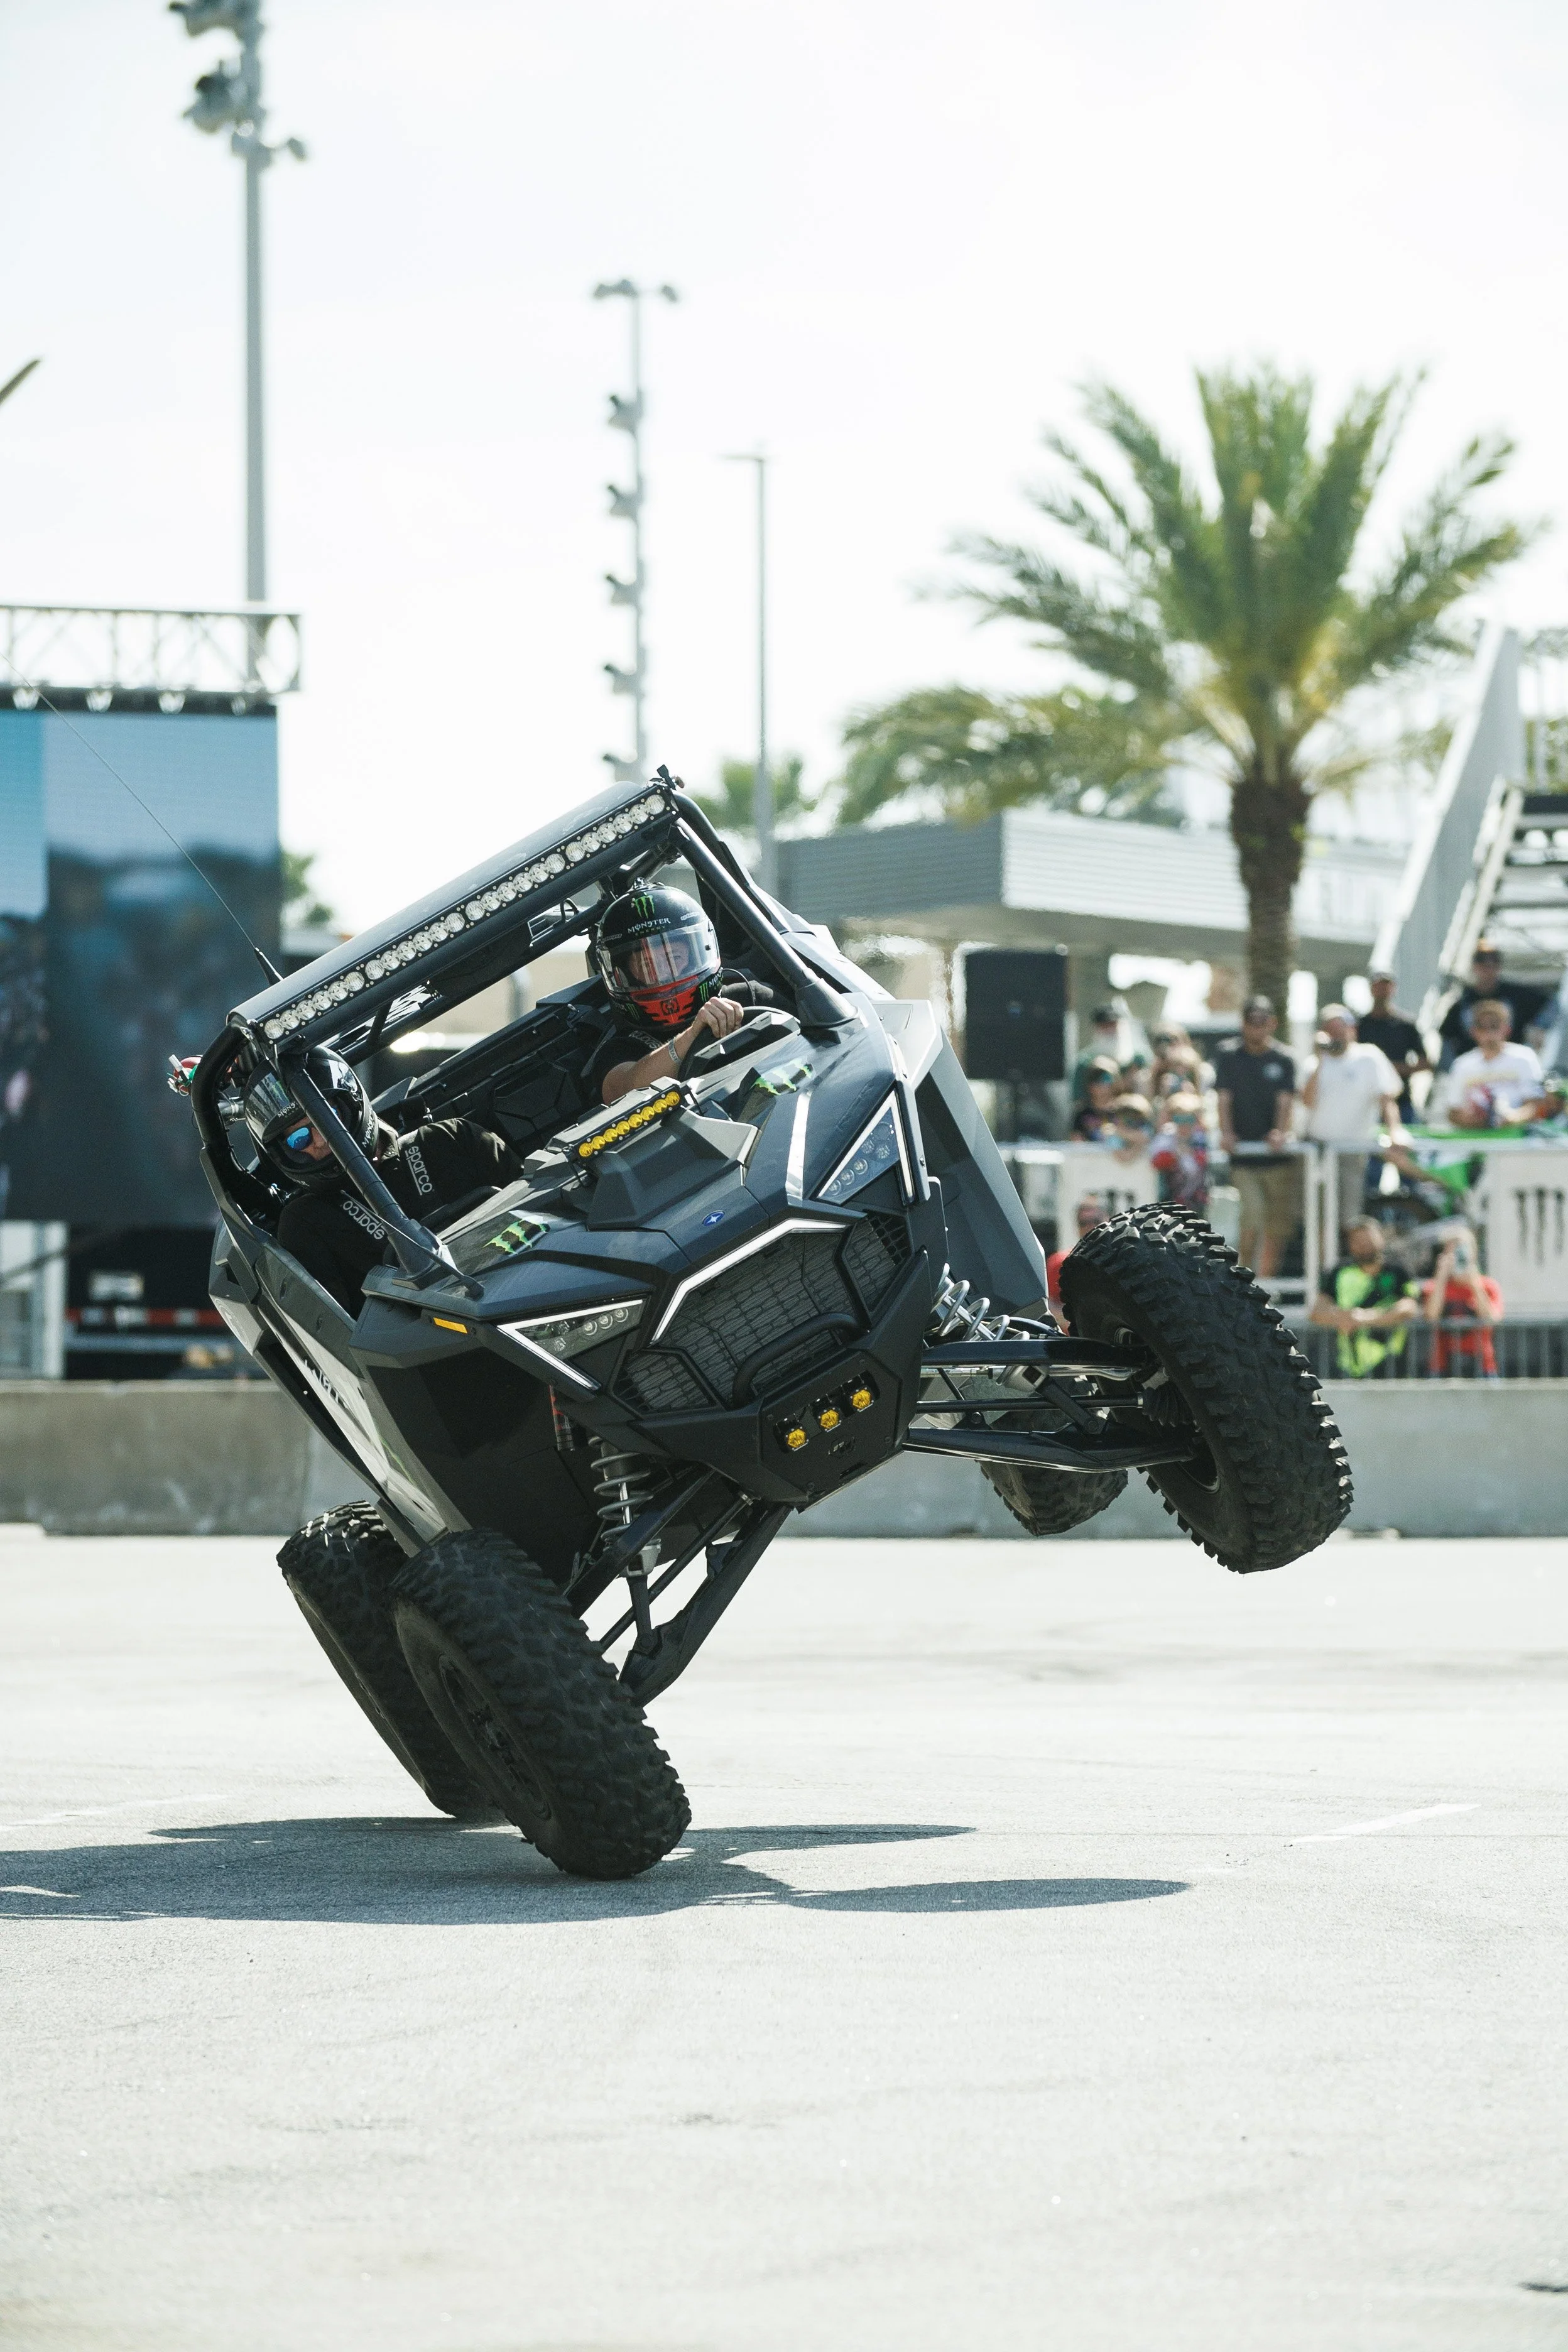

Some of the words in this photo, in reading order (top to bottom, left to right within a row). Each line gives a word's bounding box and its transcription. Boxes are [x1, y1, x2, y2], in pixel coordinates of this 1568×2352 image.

[628, 917, 671, 934] MONSTER
[406, 1146, 433, 1194] sparco
[342, 1199, 384, 1239] sparco
